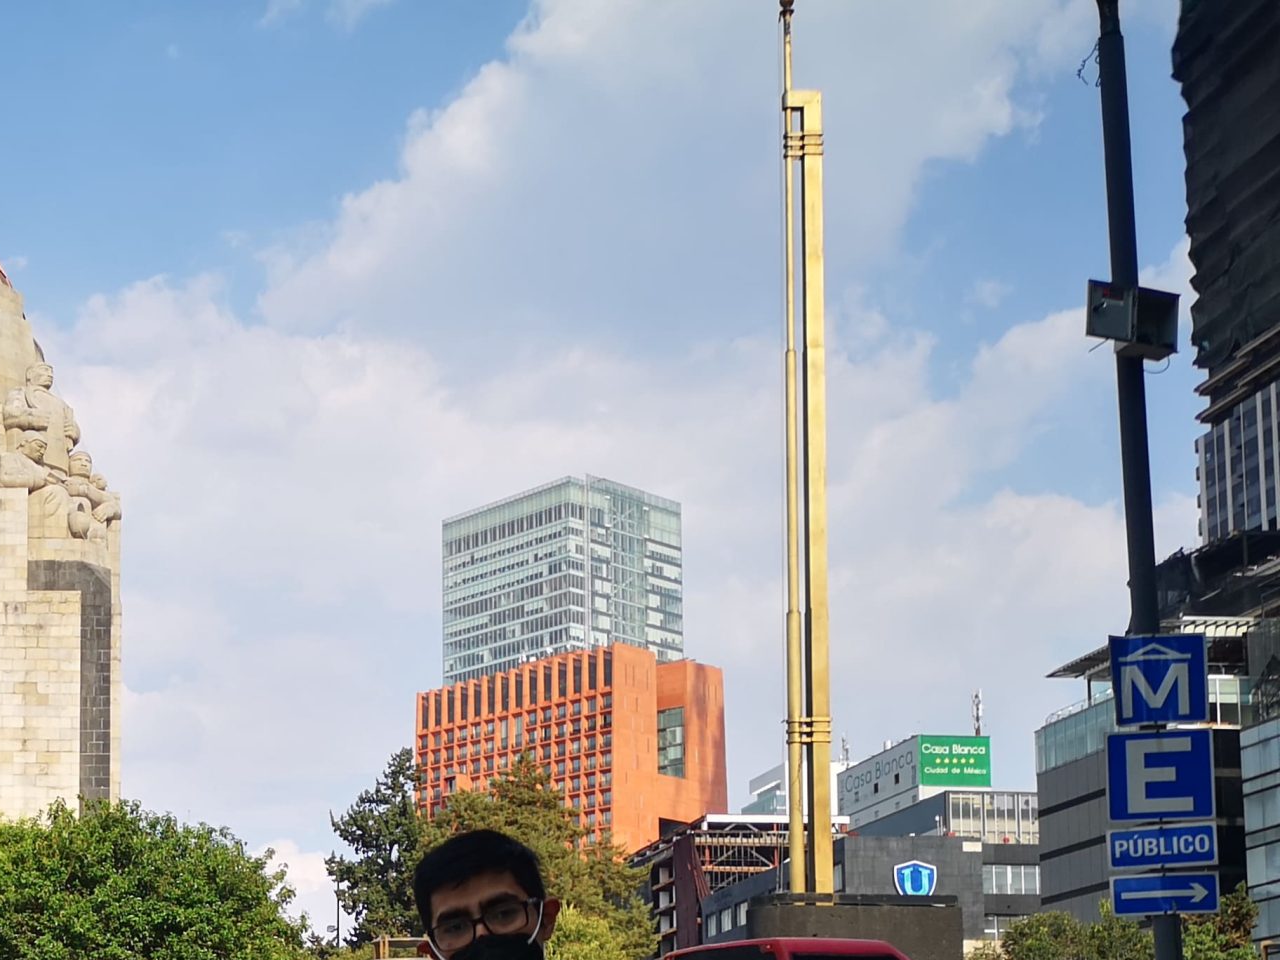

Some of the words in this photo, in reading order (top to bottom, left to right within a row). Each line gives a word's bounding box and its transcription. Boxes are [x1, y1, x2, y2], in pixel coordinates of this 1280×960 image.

[921, 743, 949, 754] Casa
[952, 743, 986, 754] Blanca
[845, 770, 872, 793] Casa
[875, 751, 913, 779] Blanca
[924, 766, 948, 774] Ciudad
[951, 766, 960, 774] de
[1125, 737, 1194, 814] E
[1114, 833, 1210, 858] PÚBLICO
